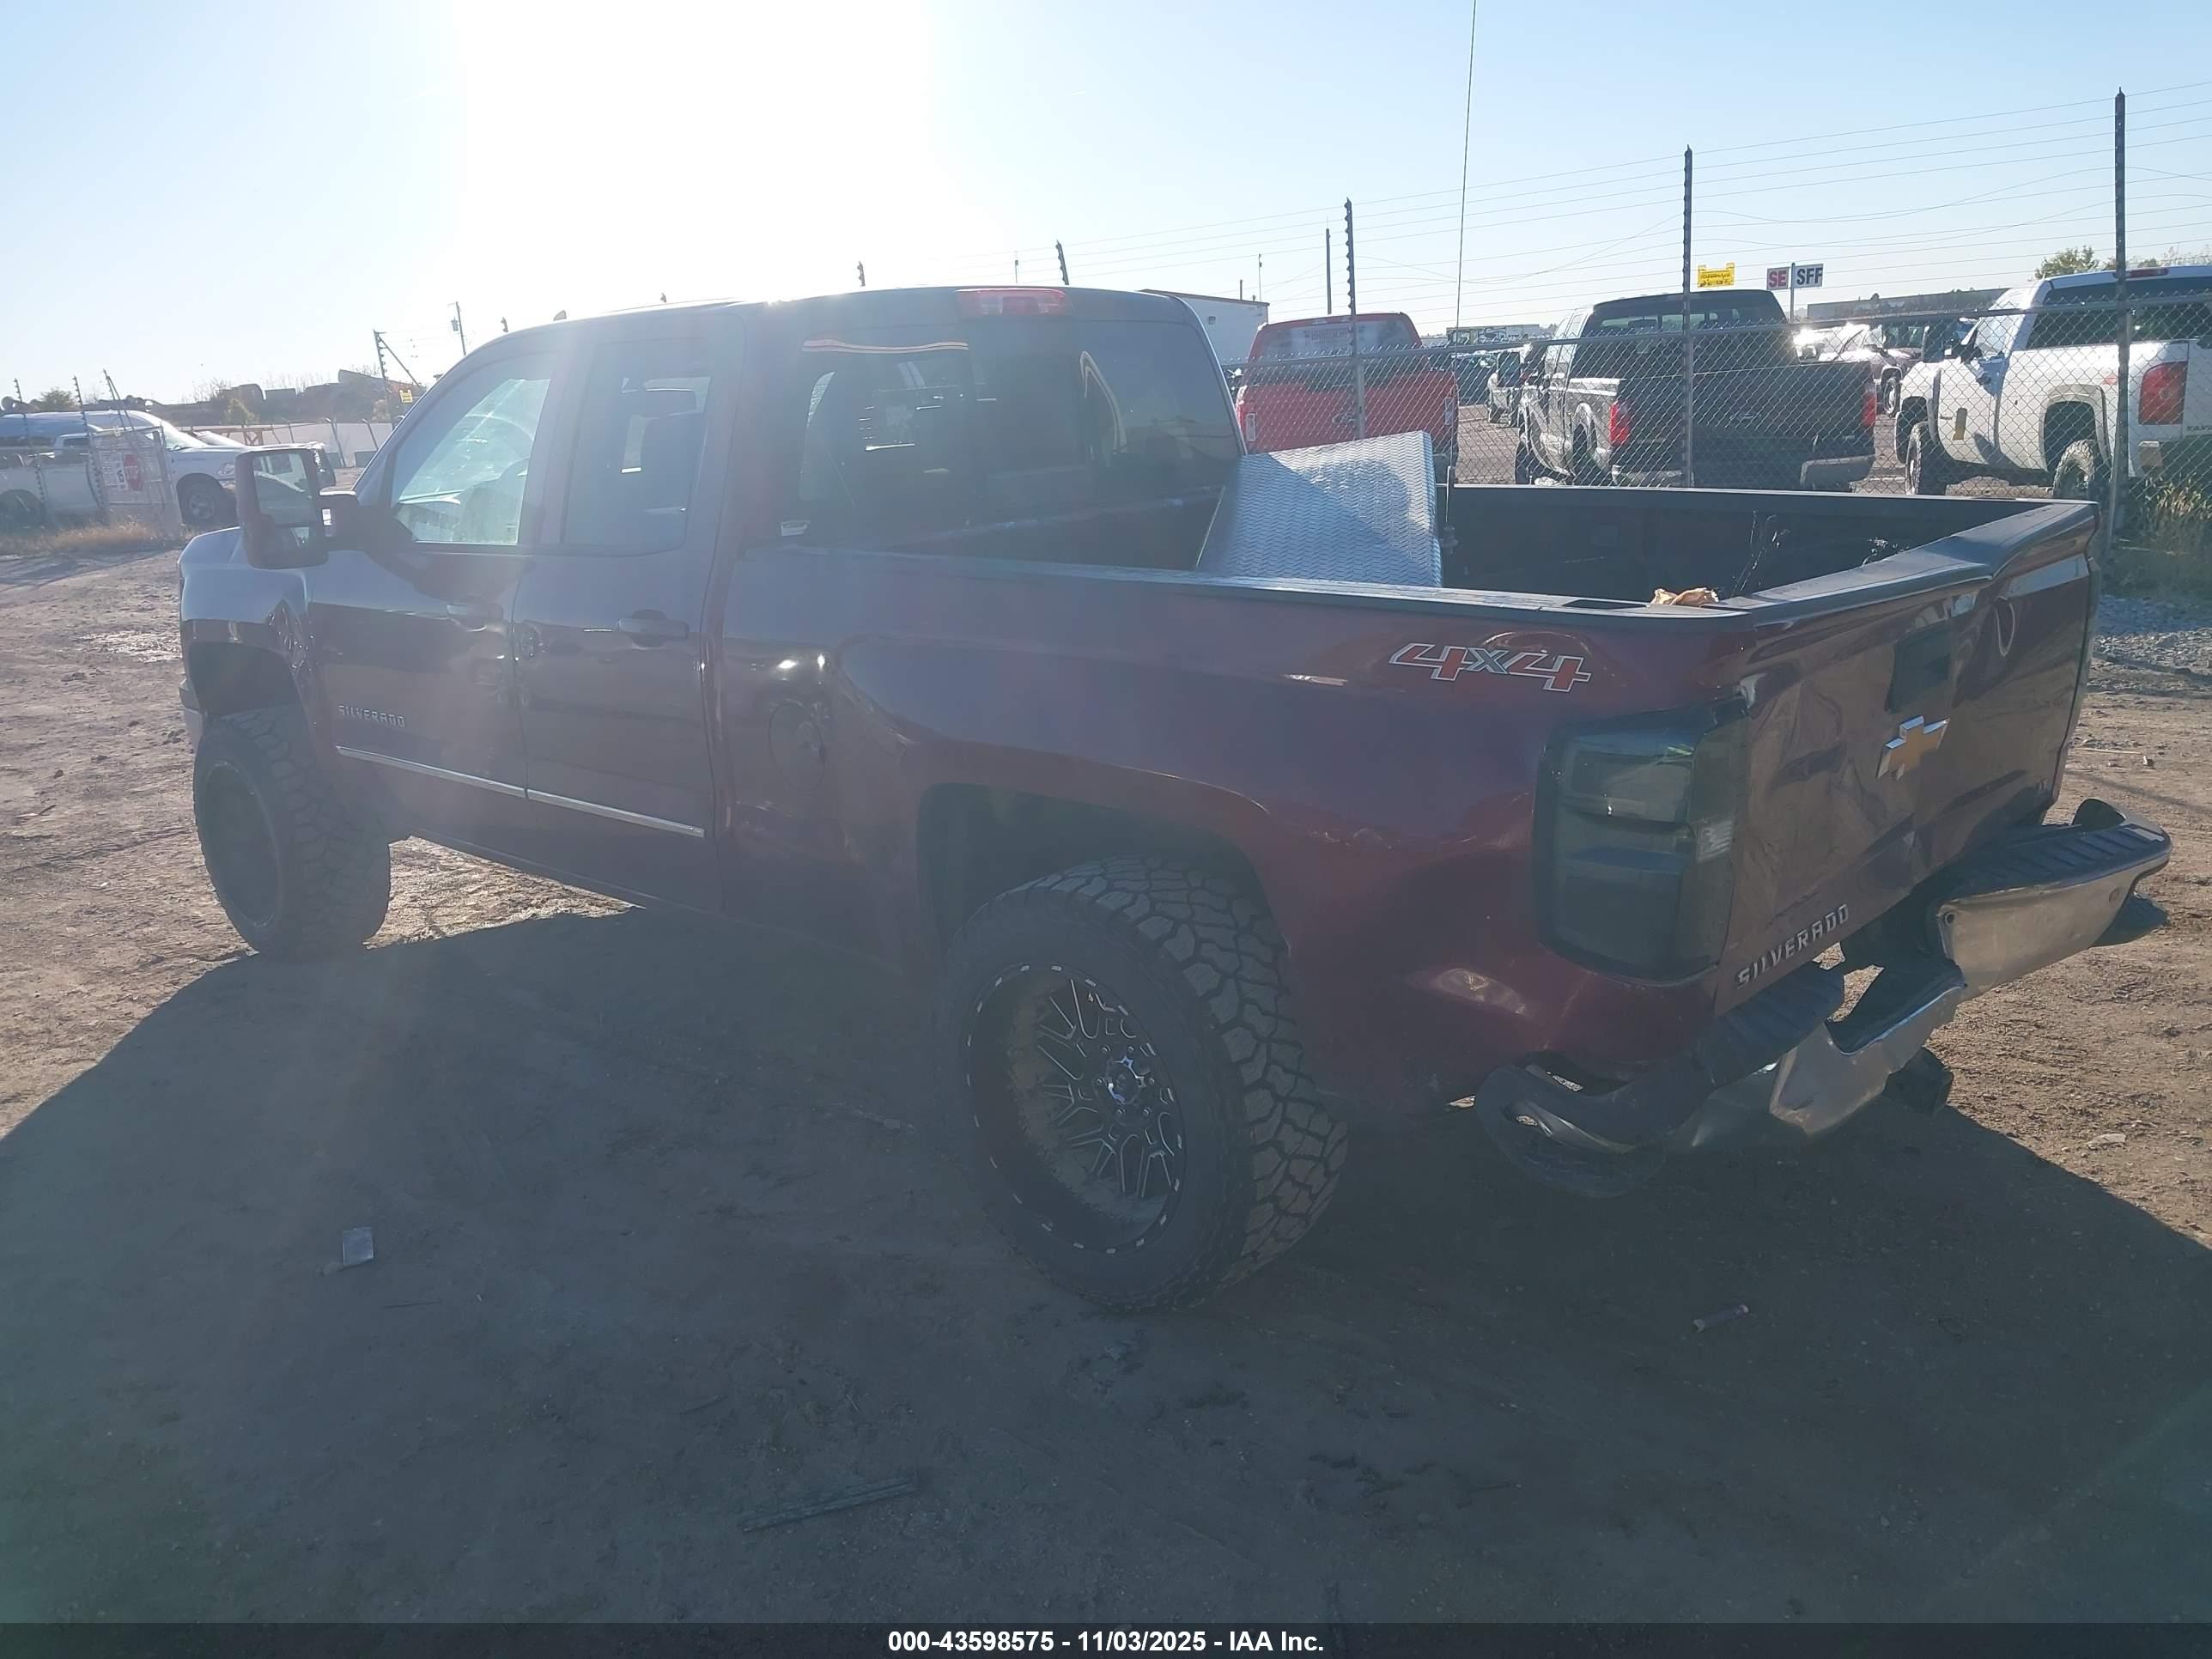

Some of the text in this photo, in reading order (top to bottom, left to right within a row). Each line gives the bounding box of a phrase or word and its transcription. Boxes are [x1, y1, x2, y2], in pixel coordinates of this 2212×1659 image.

[1768, 270, 1787, 288] SE
[1796, 268, 1823, 285] SFF
[337, 704, 406, 728] SILVERADO
[1736, 903, 1850, 989] SILVERADO
